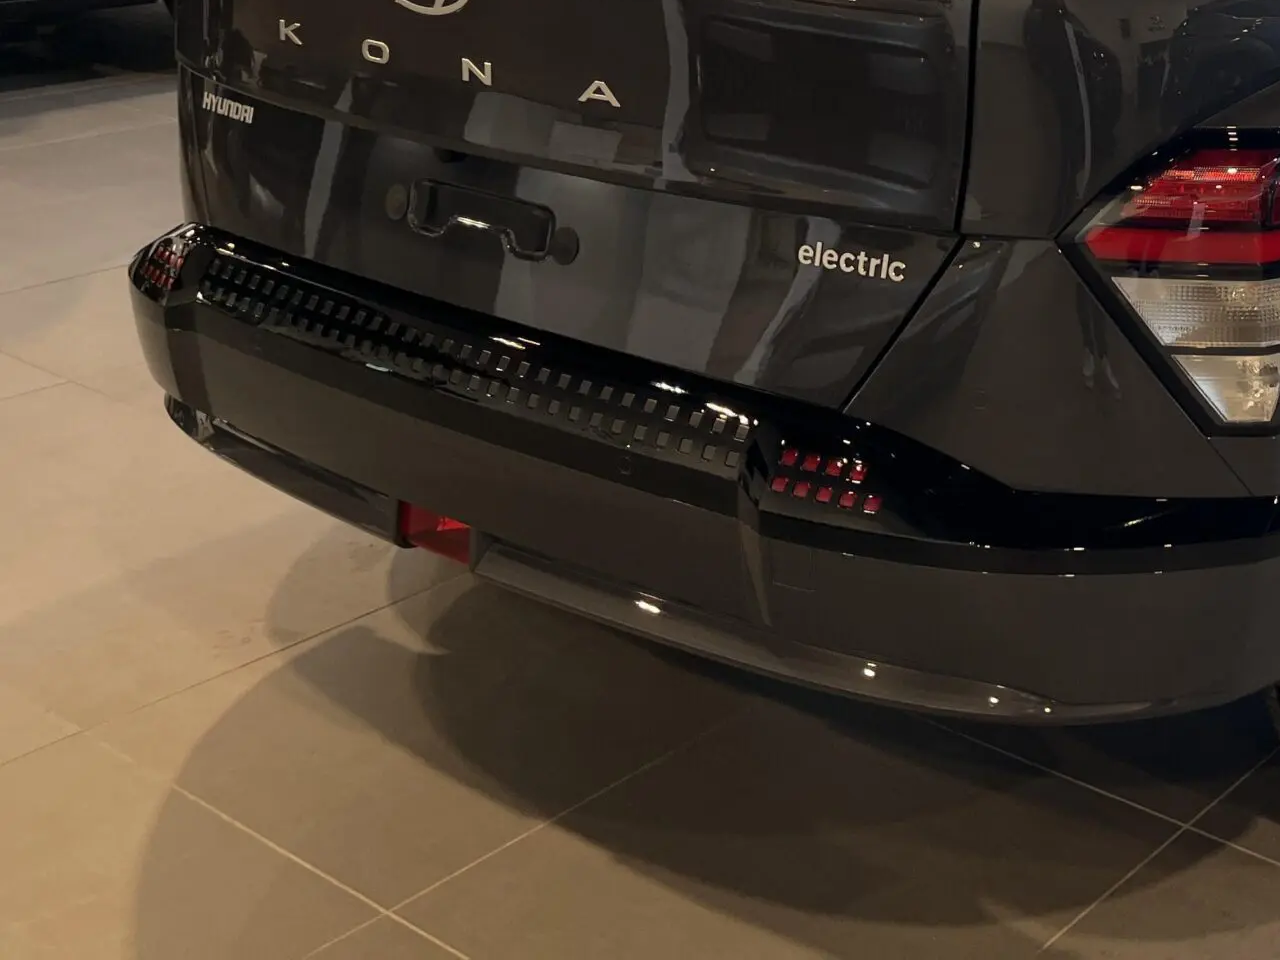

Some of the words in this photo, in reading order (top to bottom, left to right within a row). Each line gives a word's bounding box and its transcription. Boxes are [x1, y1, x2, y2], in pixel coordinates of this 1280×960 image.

[279, 19, 620, 108] KONA
[202, 91, 254, 124] HYUNDAI
[798, 242, 907, 282] electric
